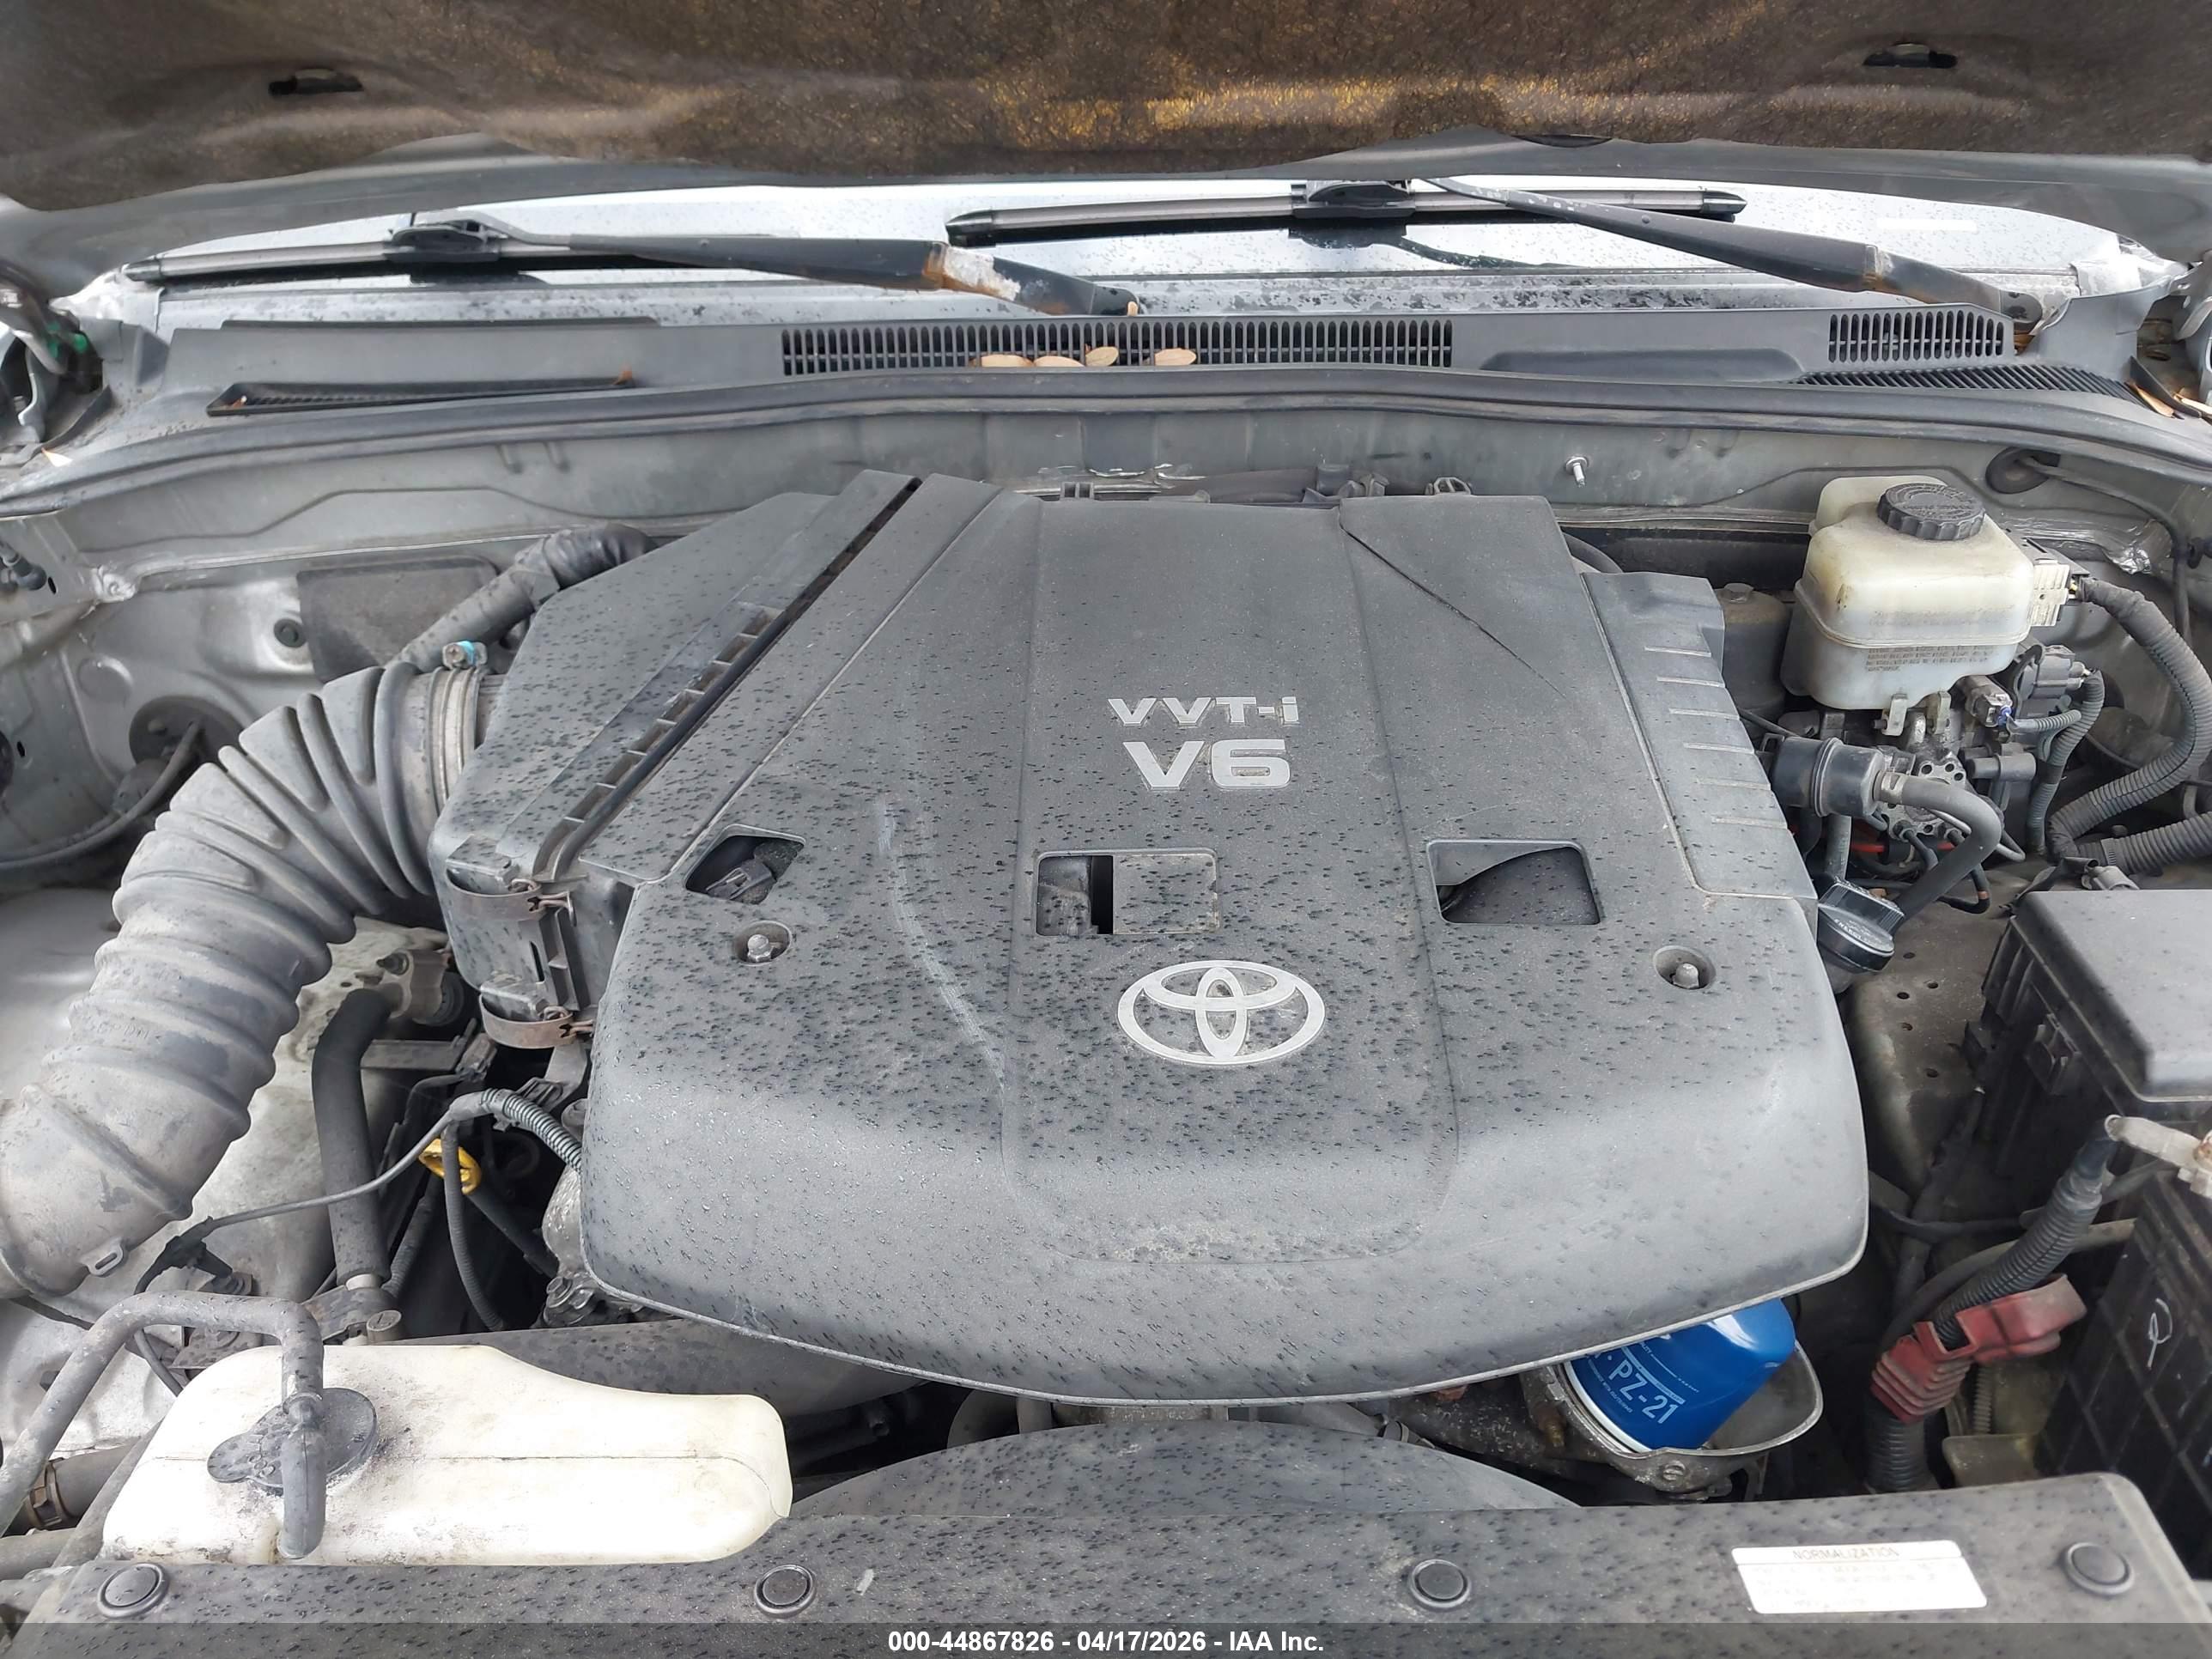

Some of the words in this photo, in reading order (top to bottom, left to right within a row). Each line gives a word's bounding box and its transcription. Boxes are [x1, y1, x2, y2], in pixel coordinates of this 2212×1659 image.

[1108, 696, 1299, 726] VVT-i
[1122, 738, 1291, 789] V6
[1608, 1359, 1680, 1424] PZ-21
[1792, 1546, 1900, 1560] NORMALIZATION
